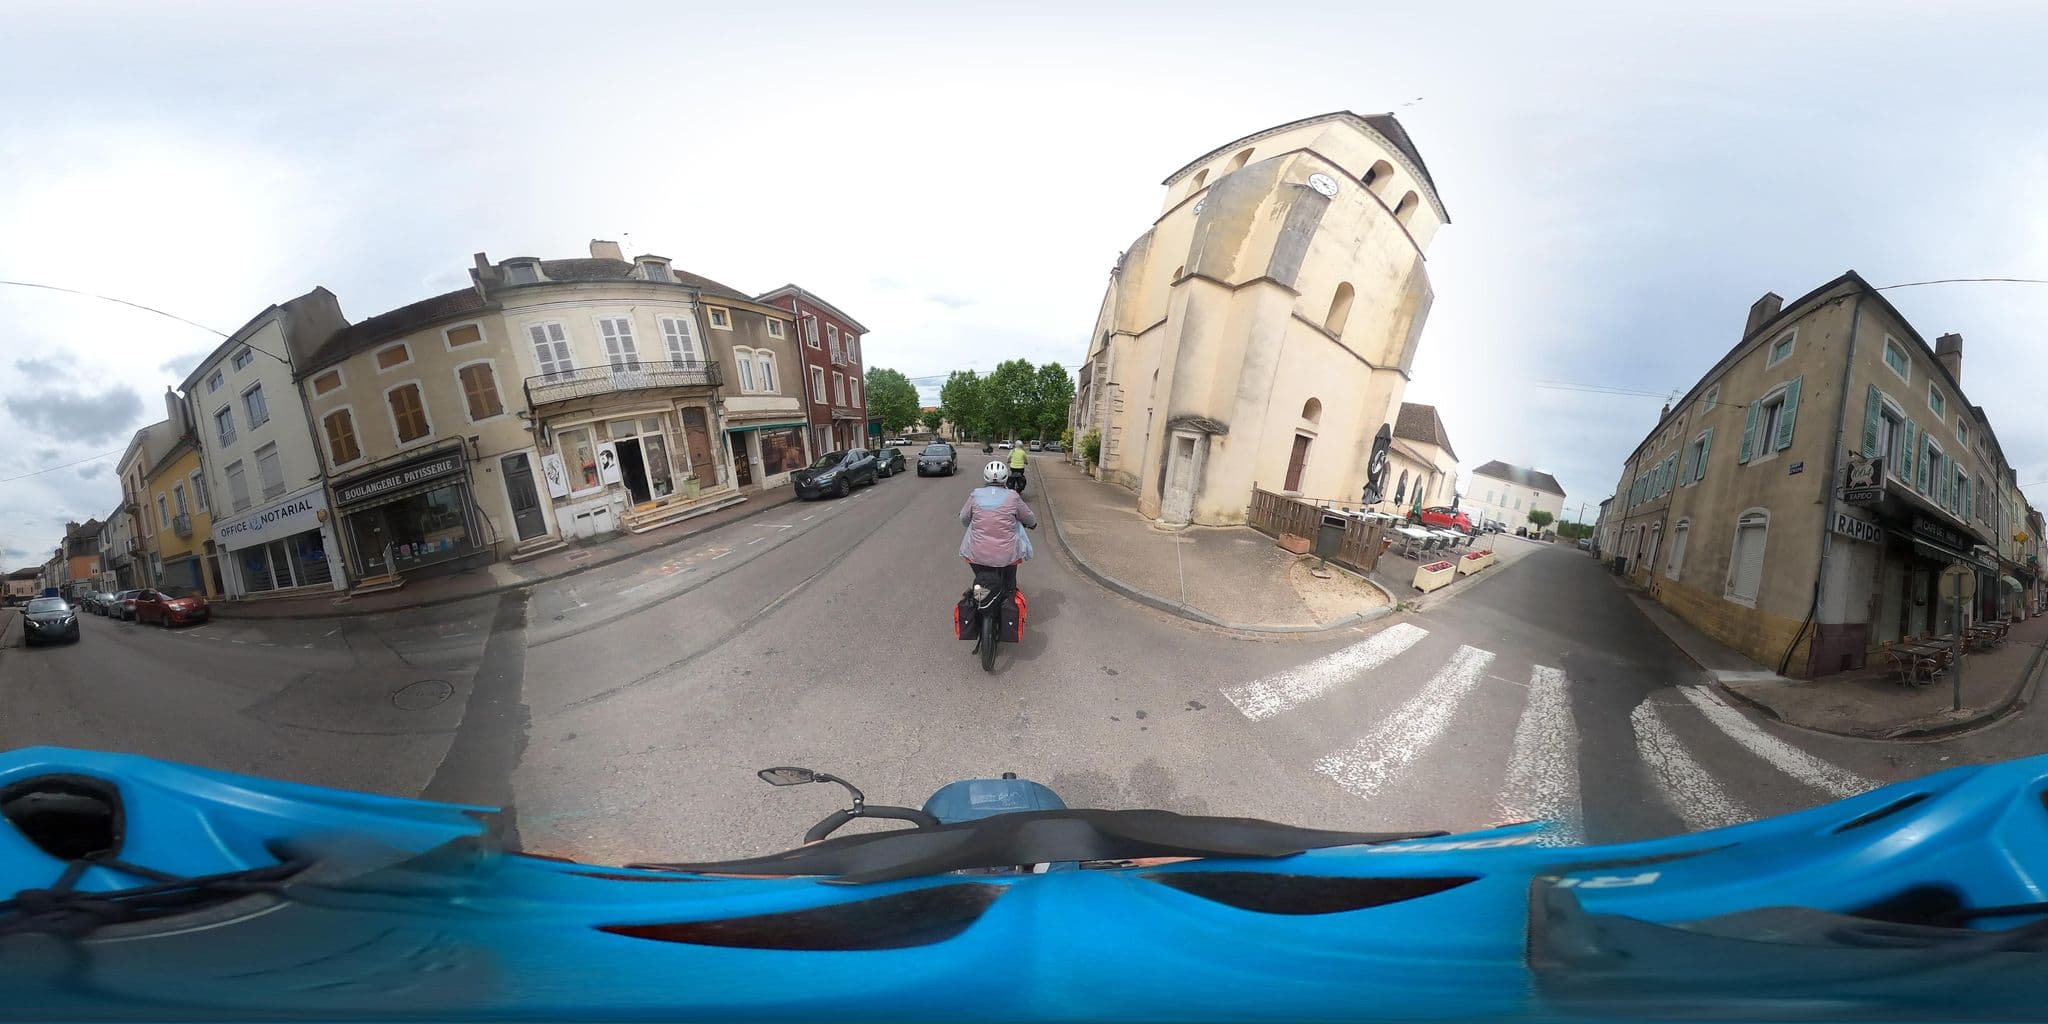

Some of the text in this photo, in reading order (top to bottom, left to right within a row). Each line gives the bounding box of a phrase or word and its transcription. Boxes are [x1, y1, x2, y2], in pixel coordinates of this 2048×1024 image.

[344, 460, 453, 500] BOULANGERIE PATISSERIE
[221, 500, 313, 538] OFFICE NOTARIAL
[1838, 514, 1881, 542] RAPIDO
